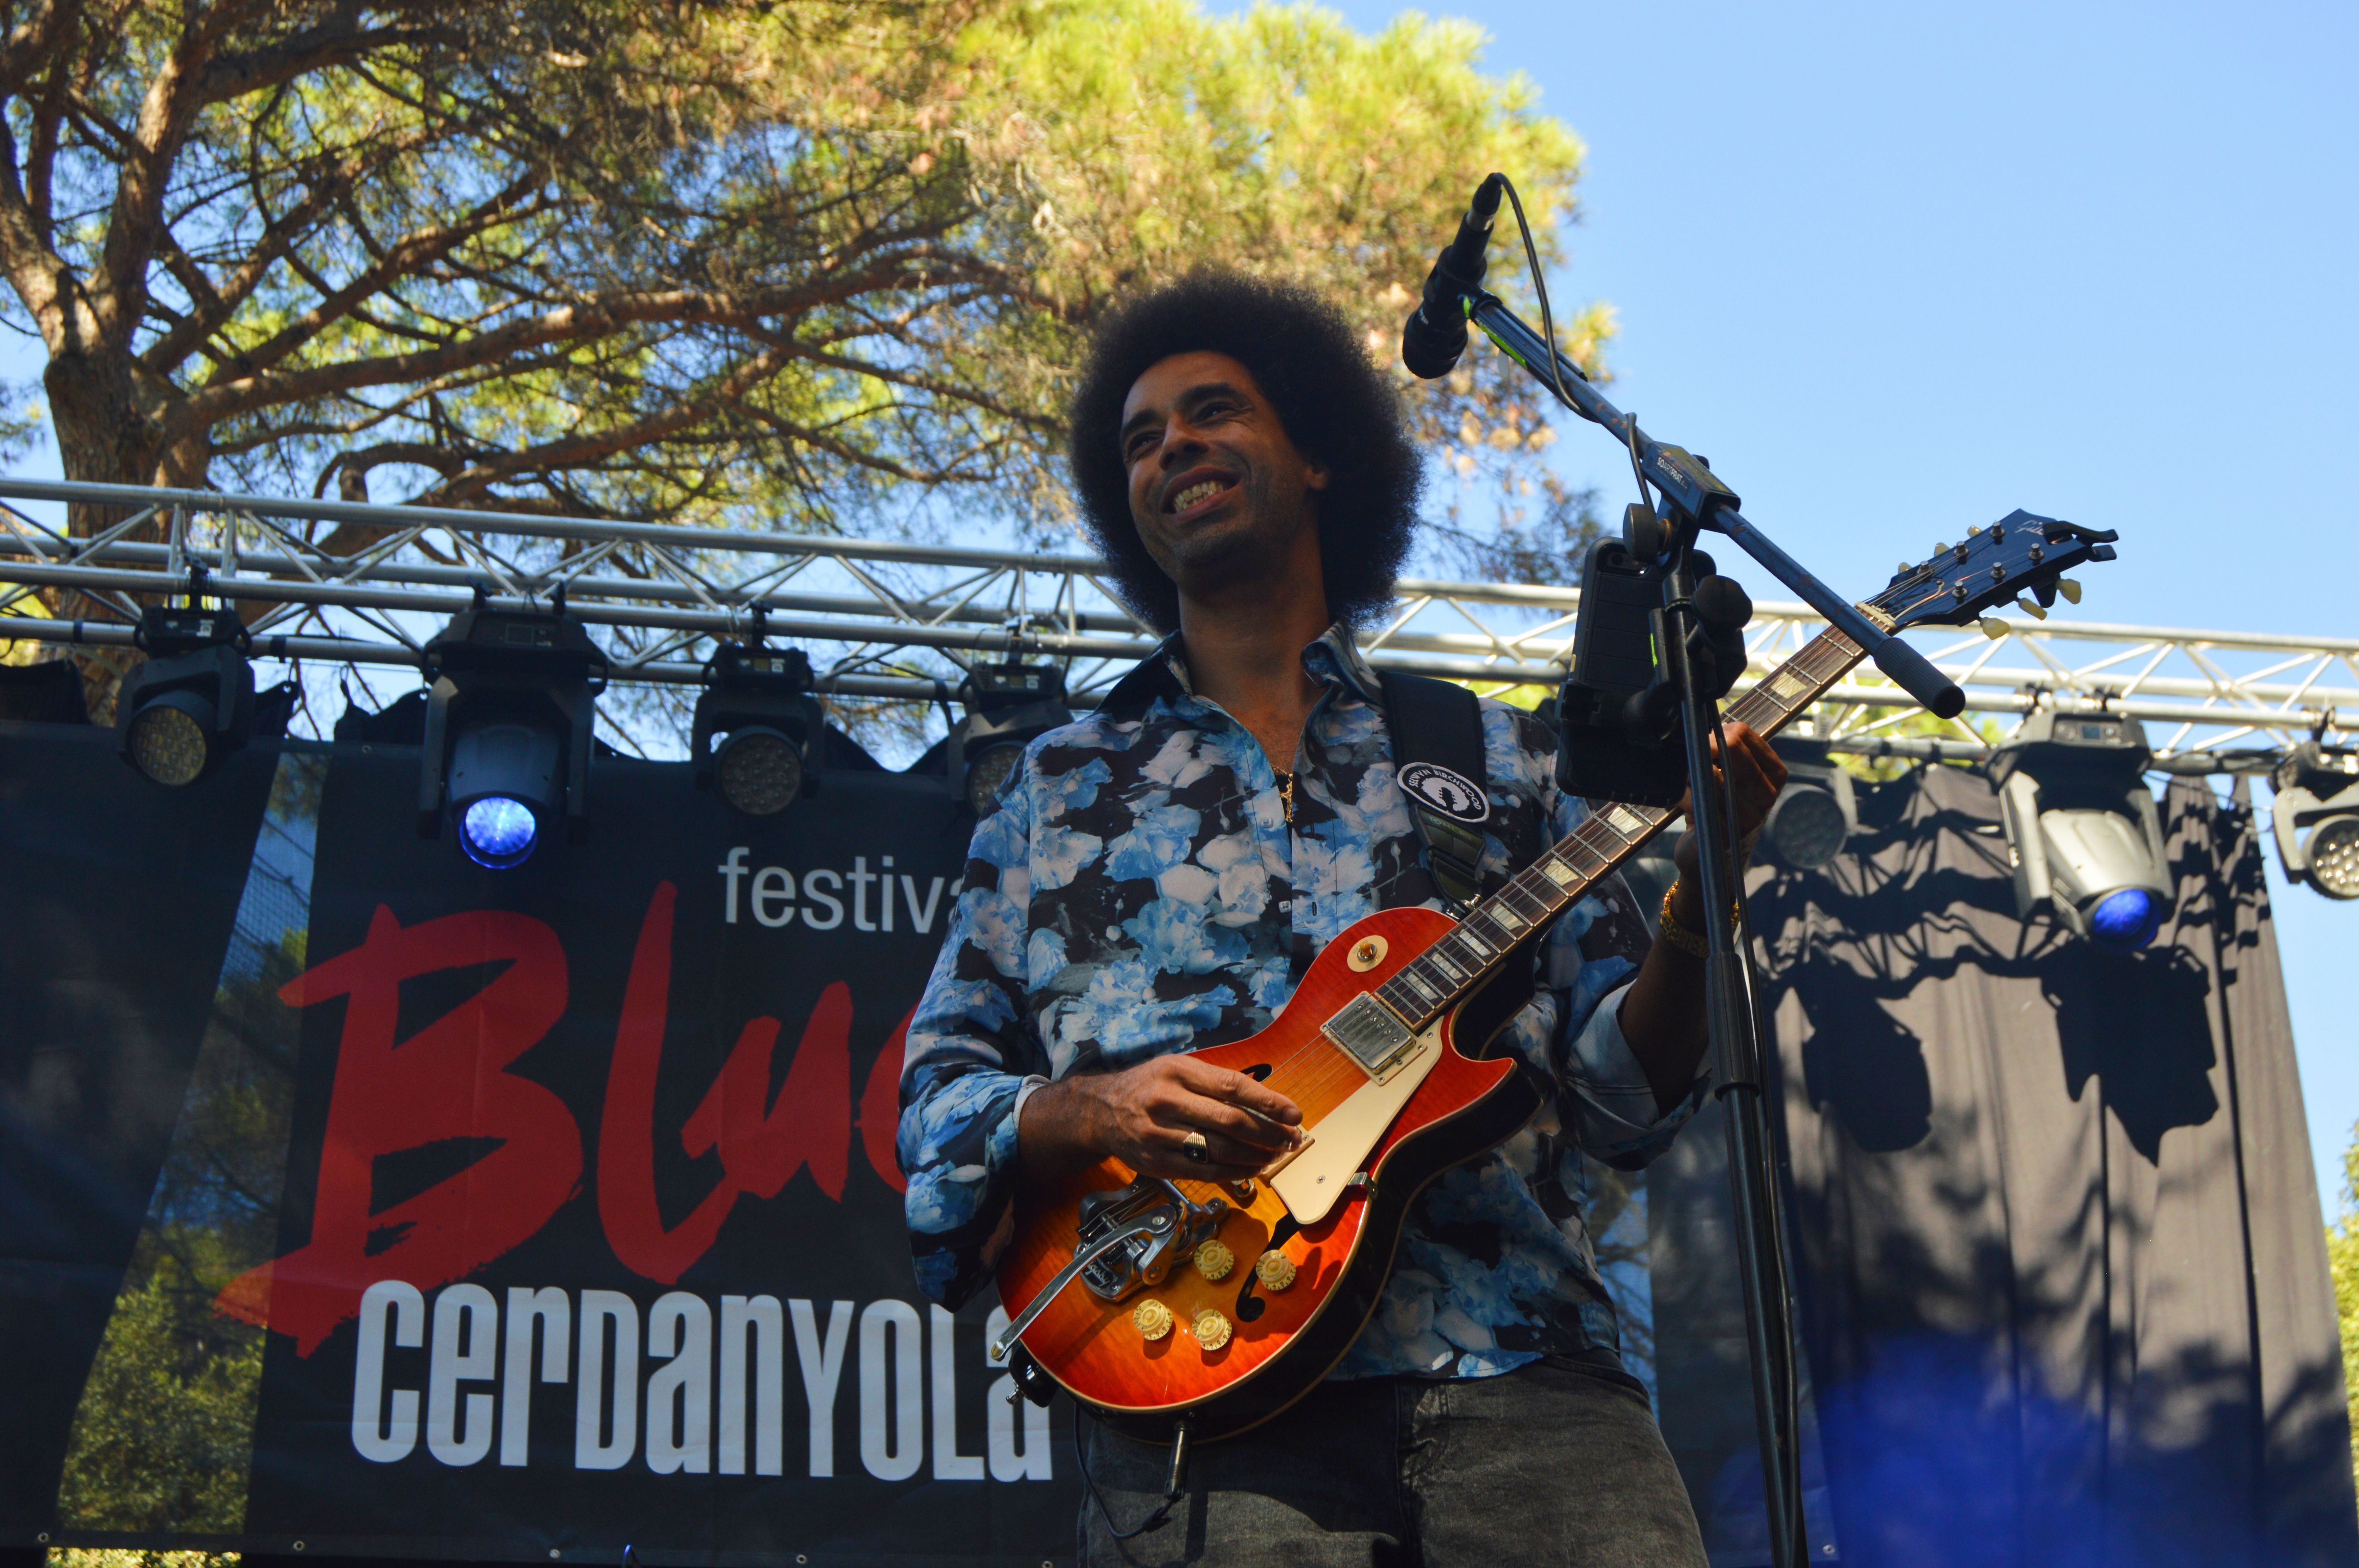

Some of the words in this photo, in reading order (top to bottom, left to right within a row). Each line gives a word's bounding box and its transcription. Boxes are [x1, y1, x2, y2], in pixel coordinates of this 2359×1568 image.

[1409, 769, 1431, 788] SELWYN
[1433, 769, 1481, 810] BIRCHWOOD
[717, 846, 962, 934] festiv
